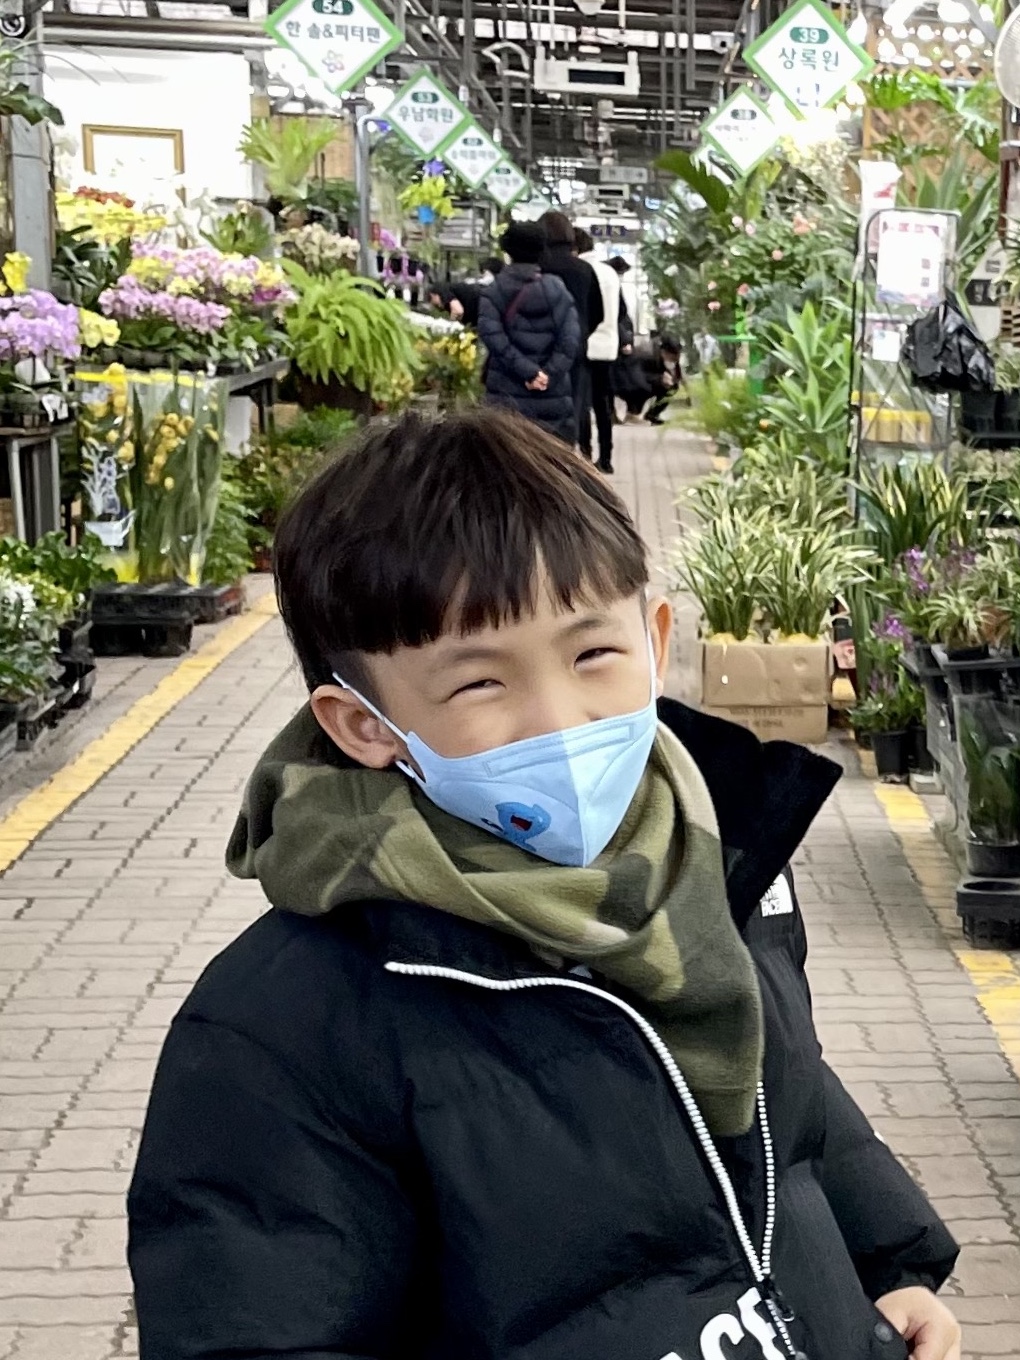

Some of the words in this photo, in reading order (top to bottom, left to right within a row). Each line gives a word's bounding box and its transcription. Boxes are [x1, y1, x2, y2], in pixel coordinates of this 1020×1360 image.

[321, 0, 344, 13] 54
[799, 29, 820, 43] 39
[778, 47, 839, 73] 상록원
